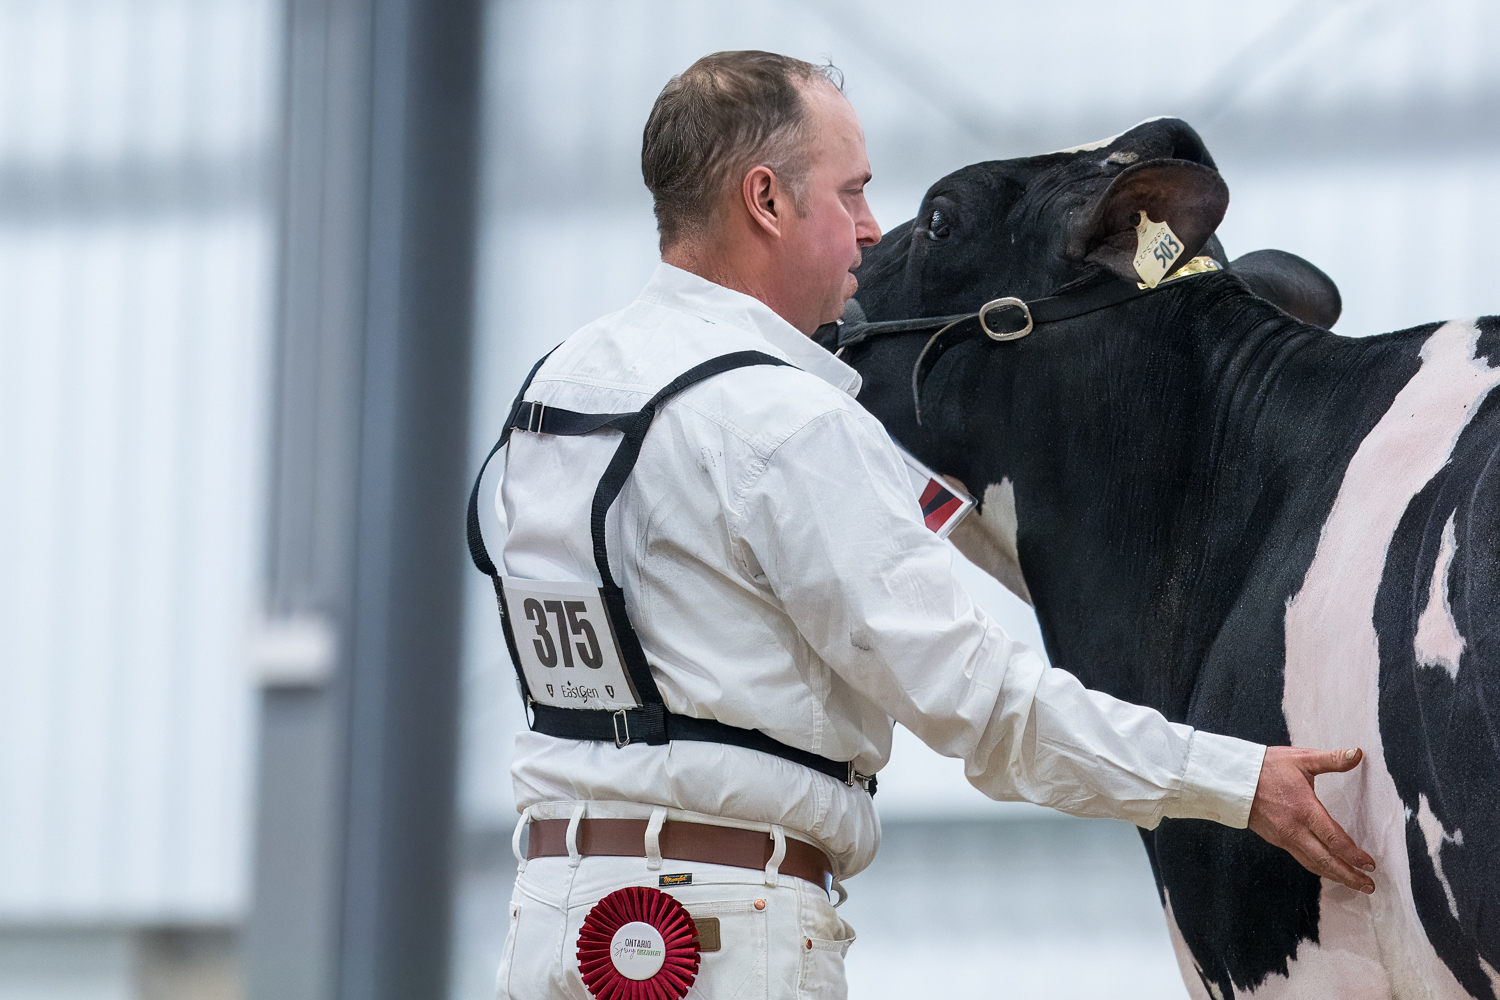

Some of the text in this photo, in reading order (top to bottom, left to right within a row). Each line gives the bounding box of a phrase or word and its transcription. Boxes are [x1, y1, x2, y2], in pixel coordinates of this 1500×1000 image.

[1153, 233, 1180, 269] 503
[523, 597, 604, 669] 375
[560, 684, 600, 702] EastGen
[624, 938, 652, 949] ONTARIO
